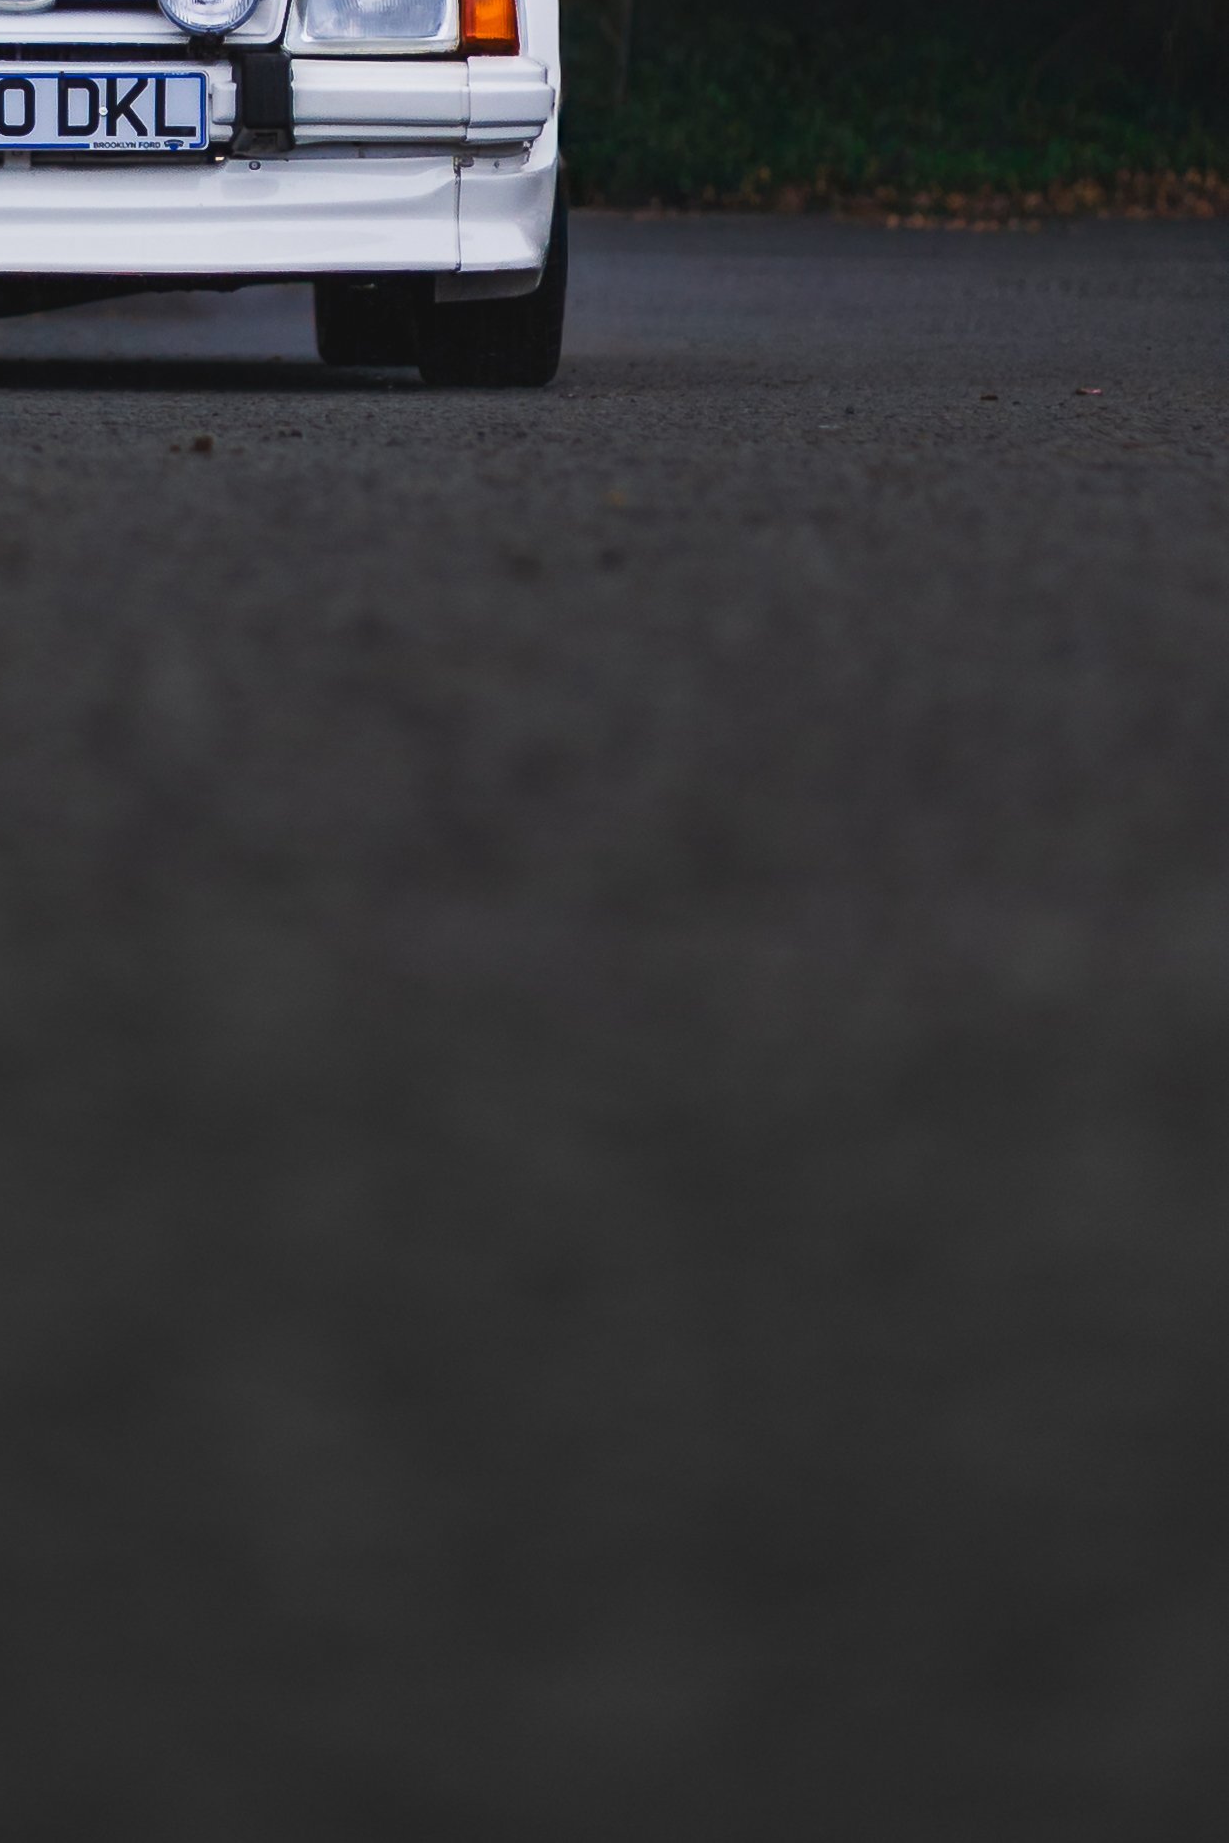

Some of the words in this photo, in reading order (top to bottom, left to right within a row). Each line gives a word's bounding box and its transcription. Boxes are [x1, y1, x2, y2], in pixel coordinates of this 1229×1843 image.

[58, 77, 197, 137] DKL
[93, 141, 137, 149] BROOKLYN
[138, 141, 161, 149] FORD
